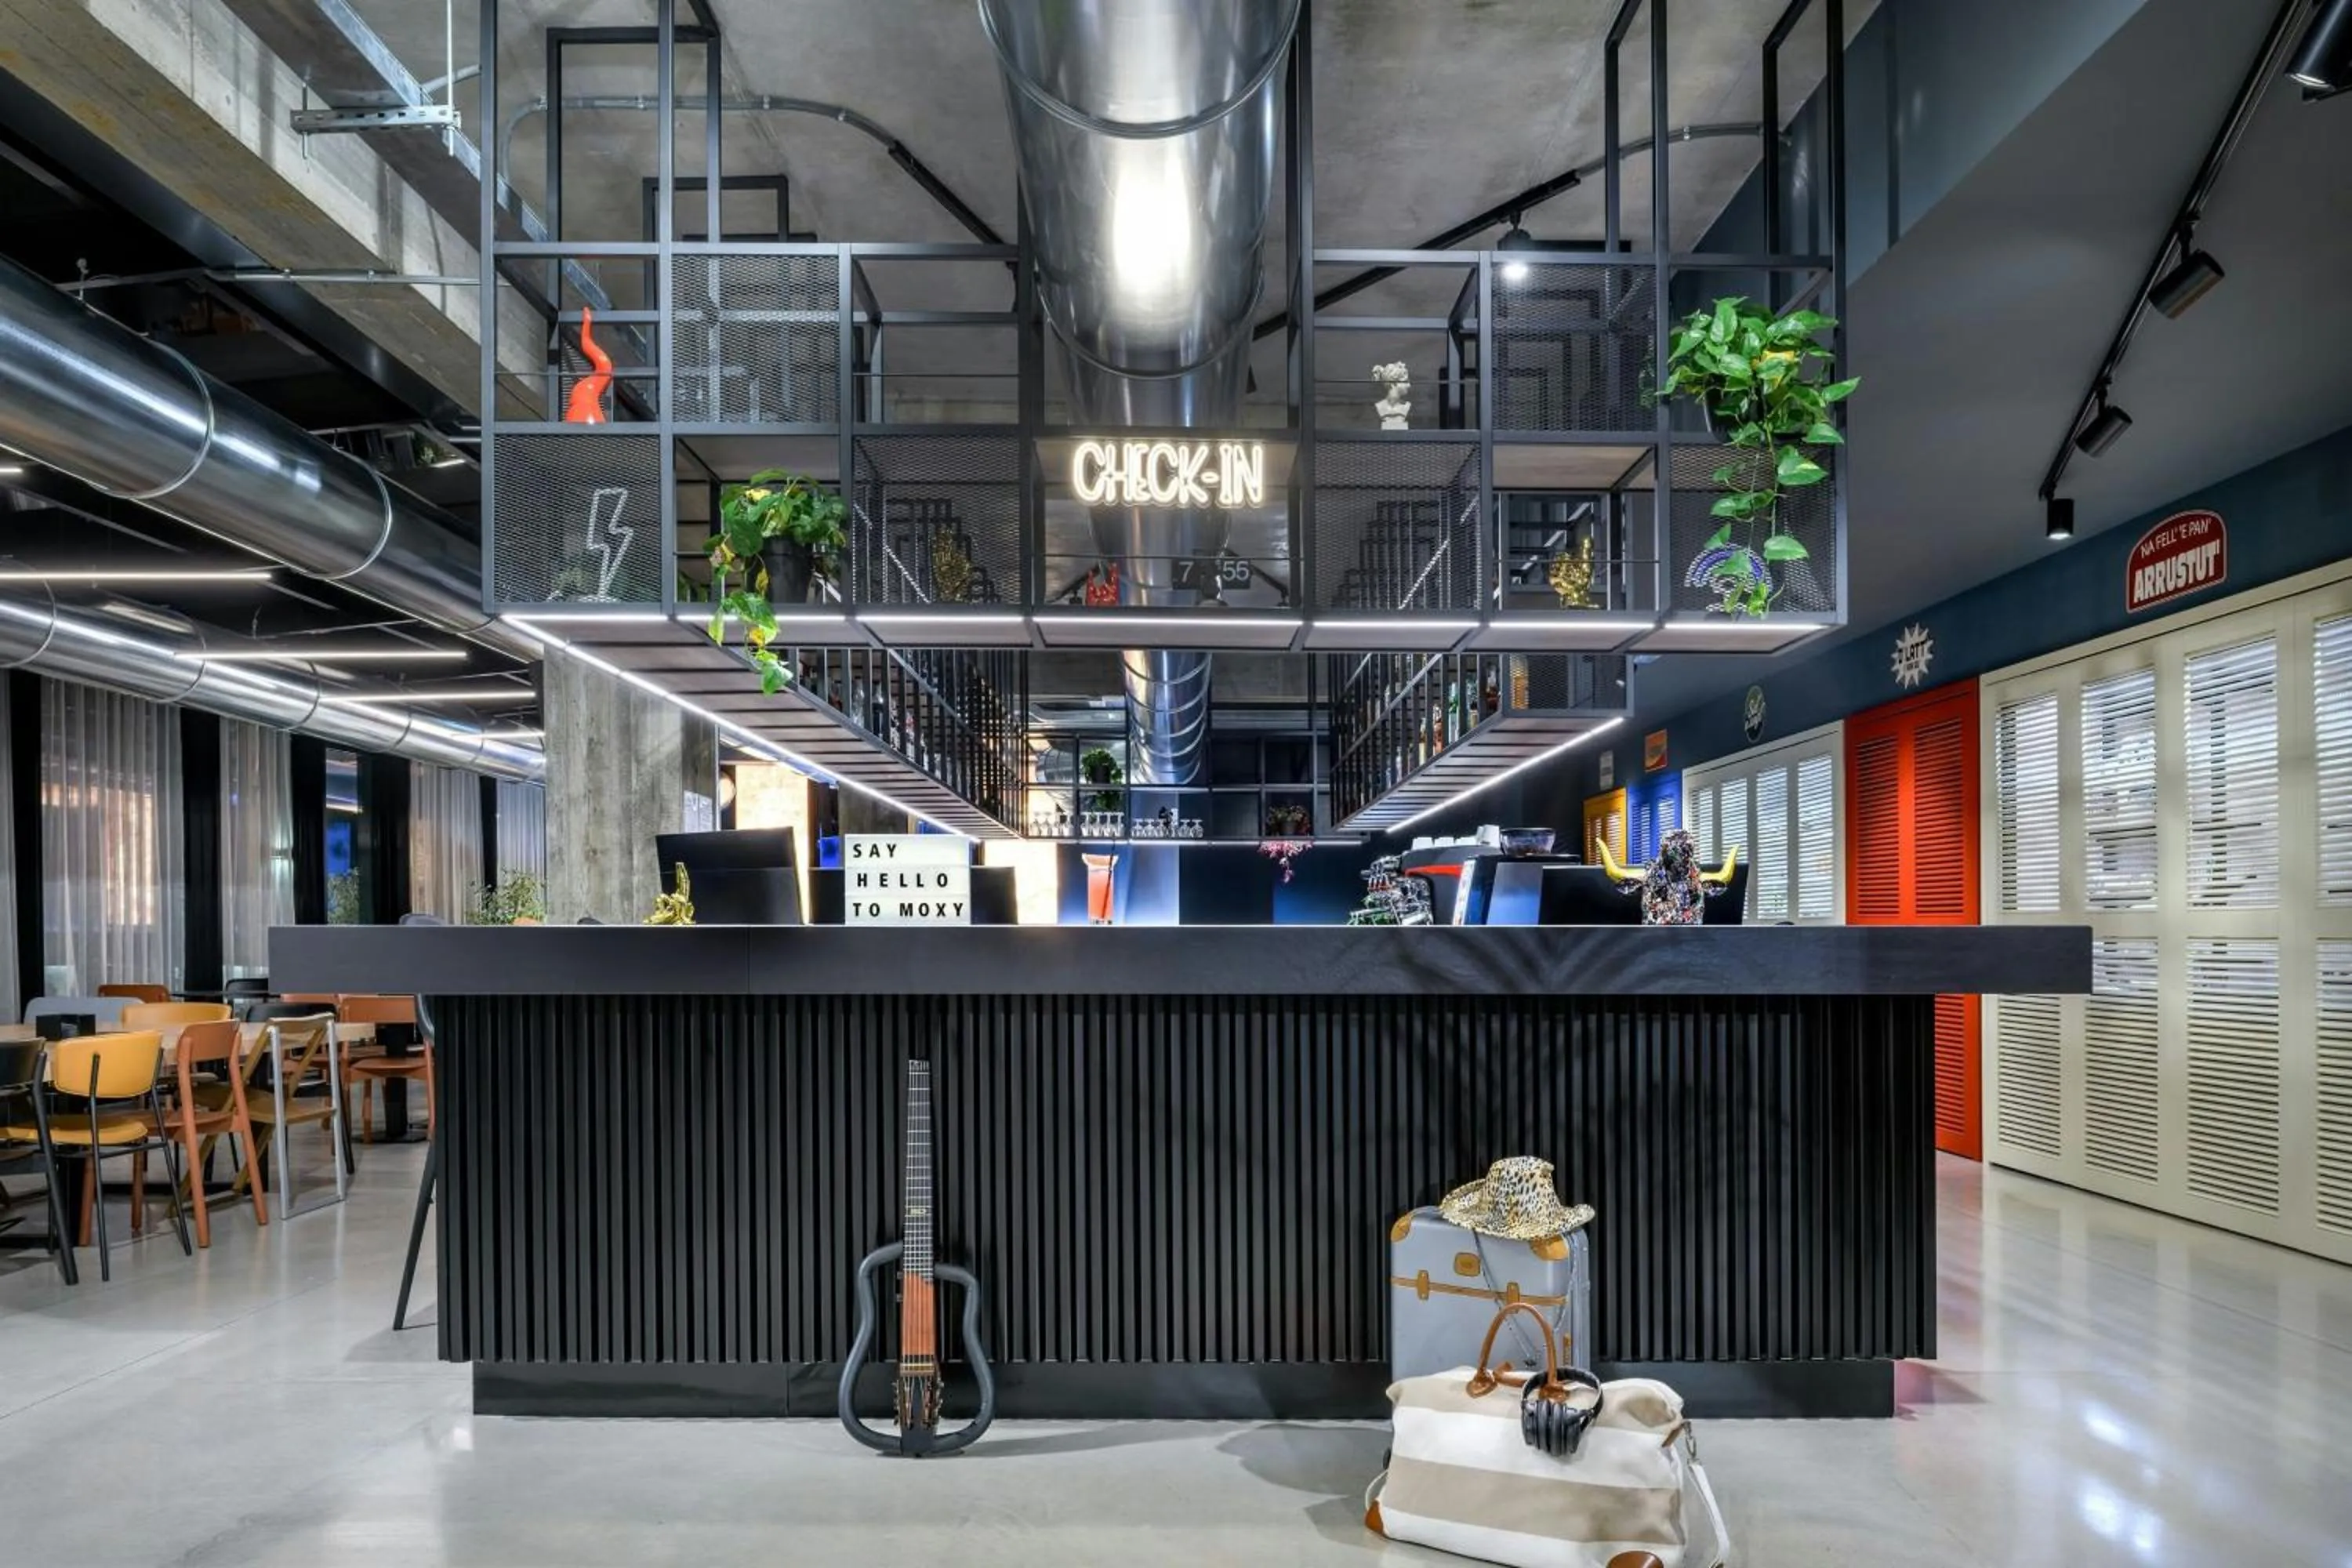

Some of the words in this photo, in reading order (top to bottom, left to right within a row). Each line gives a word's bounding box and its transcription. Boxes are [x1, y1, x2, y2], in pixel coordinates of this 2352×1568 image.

[1073, 441, 1263, 503] CHECK-IN
[2140, 540, 2155, 559] NA
[1179, 561, 1194, 583] 7
[1222, 561, 1250, 581] 56
[853, 843, 897, 858] SAY
[857, 873, 949, 887] HELLO
[852, 902, 880, 917] TO
[899, 902, 964, 917] MOXY
